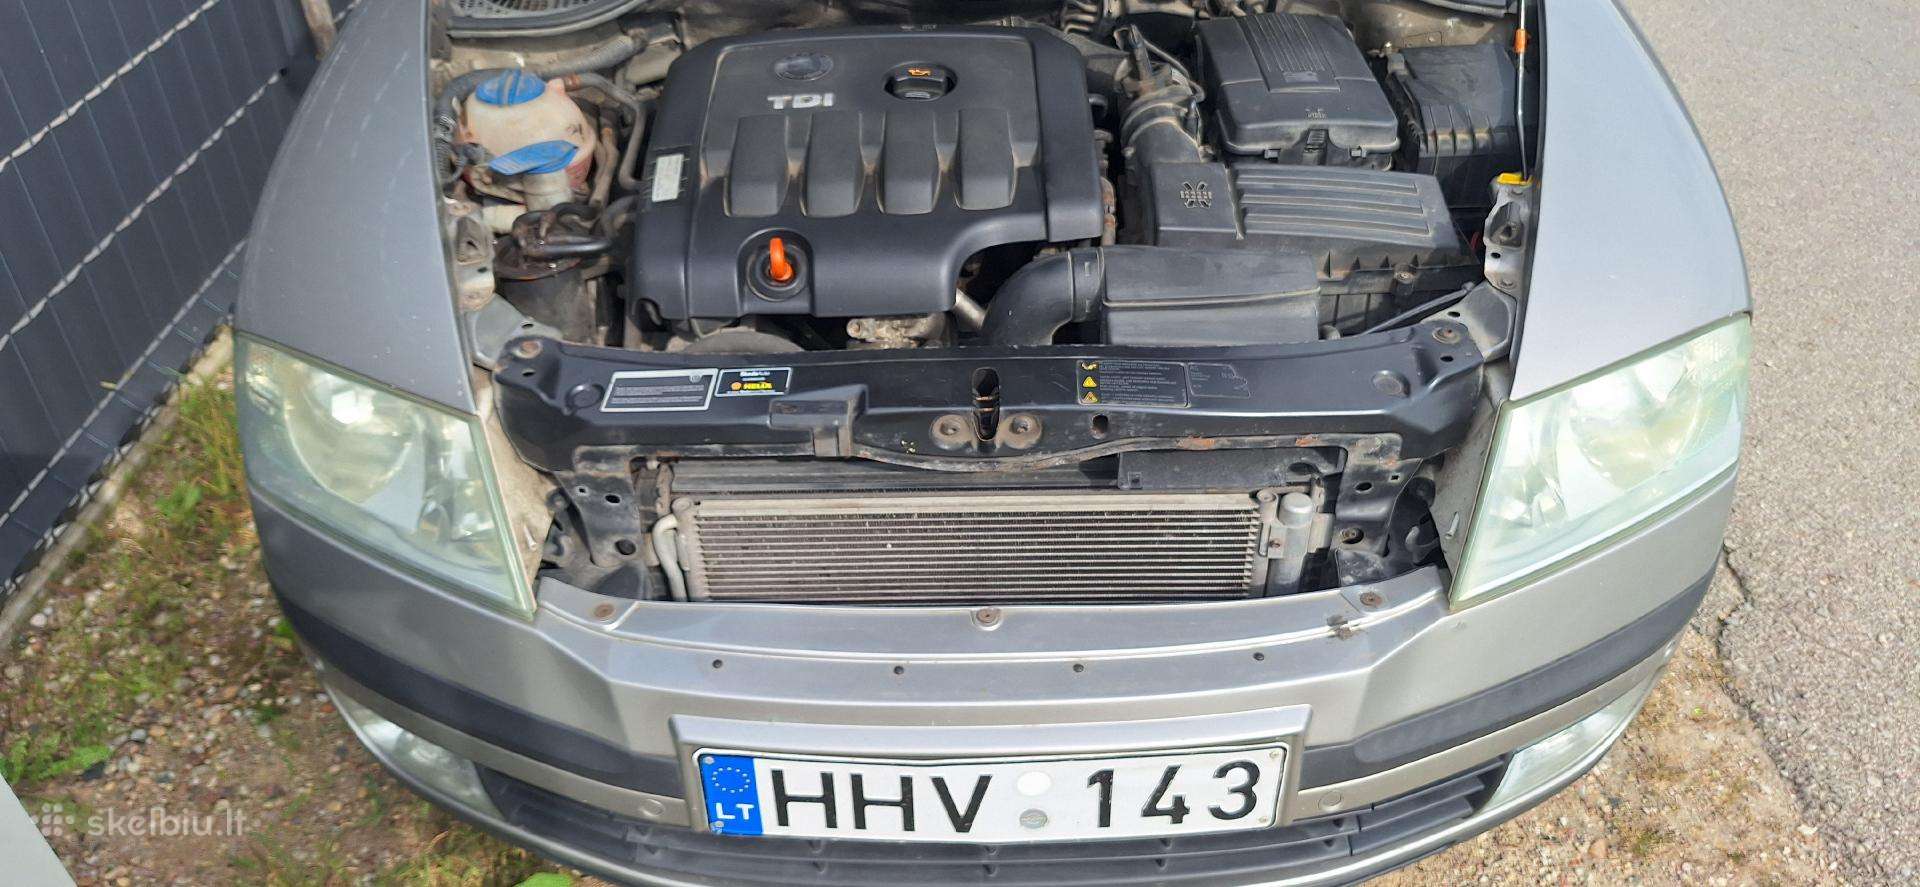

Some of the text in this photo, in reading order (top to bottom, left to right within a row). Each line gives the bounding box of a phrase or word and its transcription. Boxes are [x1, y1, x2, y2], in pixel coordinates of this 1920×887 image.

[767, 93, 834, 110] TDI
[771, 759, 1261, 833] HHV 143
[715, 802, 755, 821] LT
